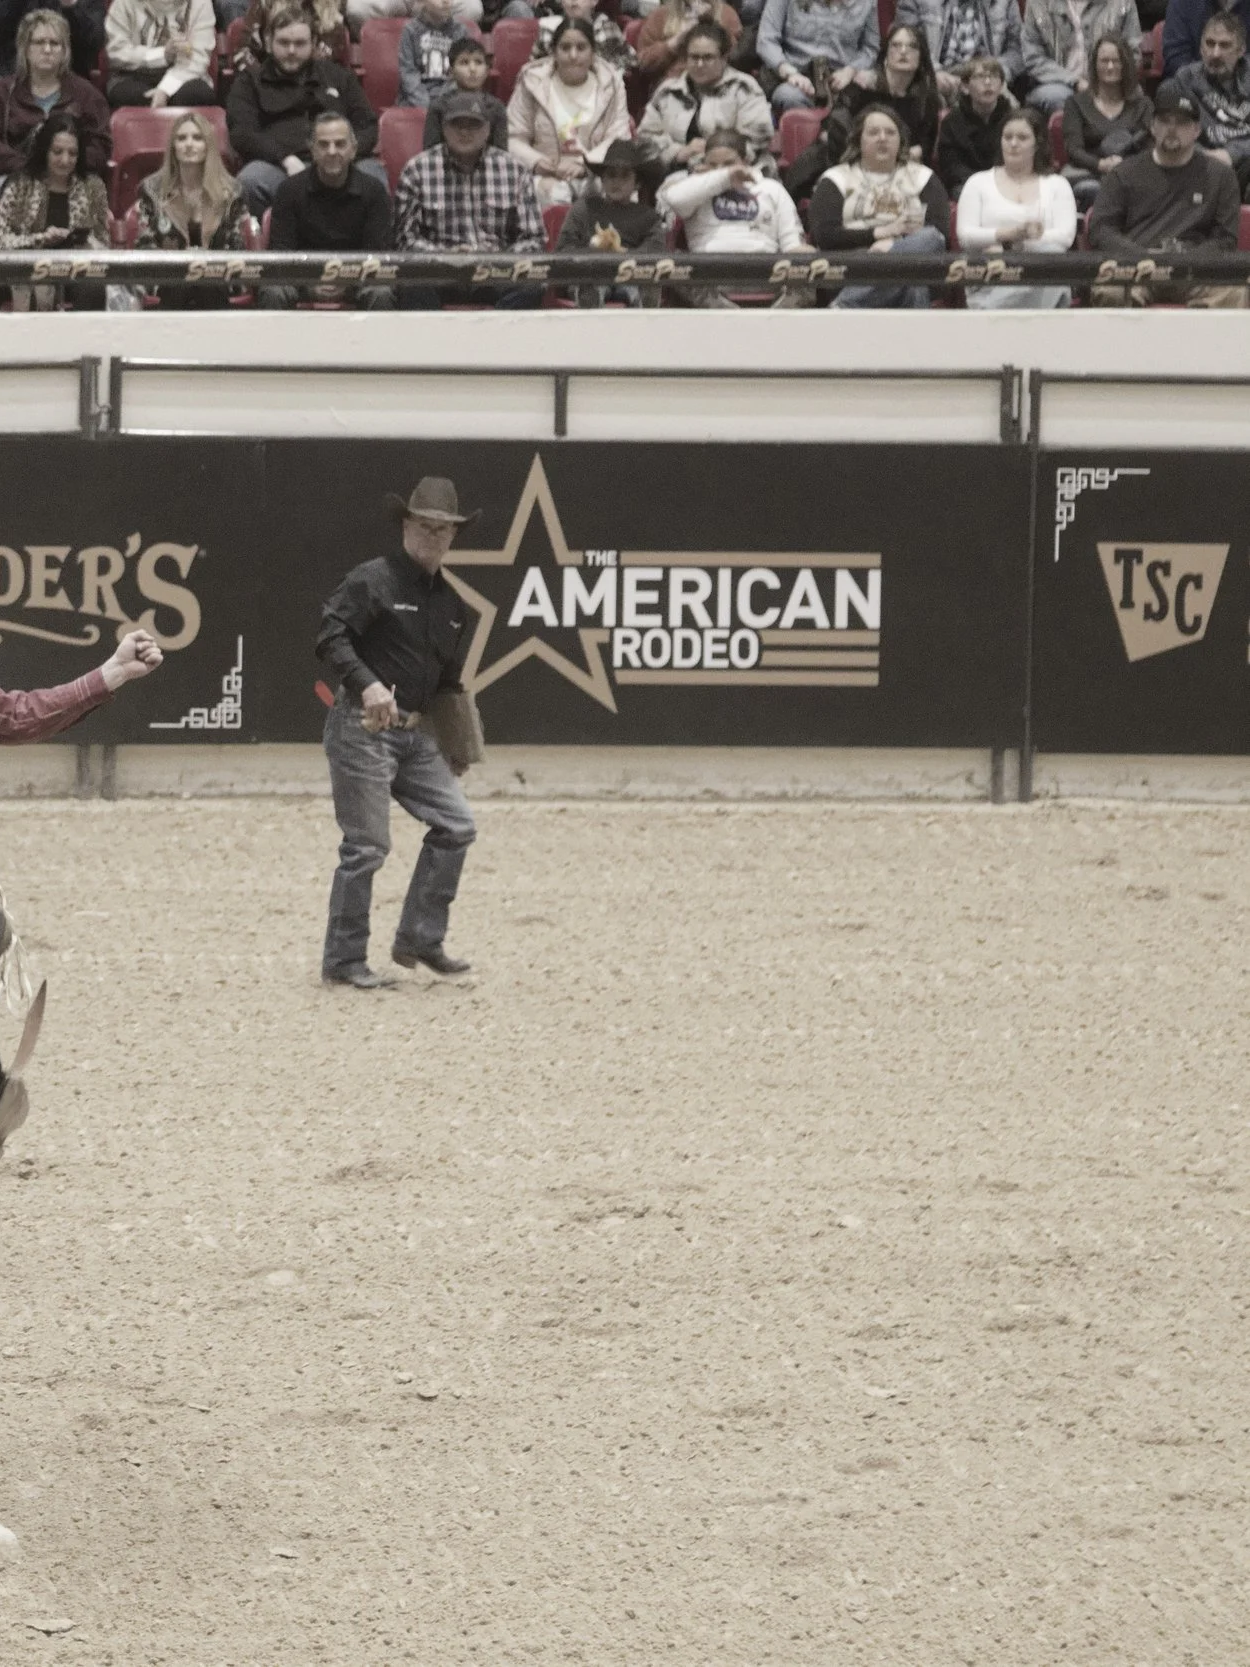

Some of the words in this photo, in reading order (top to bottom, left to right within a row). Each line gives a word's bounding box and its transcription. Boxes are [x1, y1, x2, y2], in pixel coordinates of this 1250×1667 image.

[586, 550, 617, 566] THE
[508, 567, 881, 629] AMERICAN
[1113, 548, 1203, 637] TSC
[612, 628, 760, 669] RODEO
